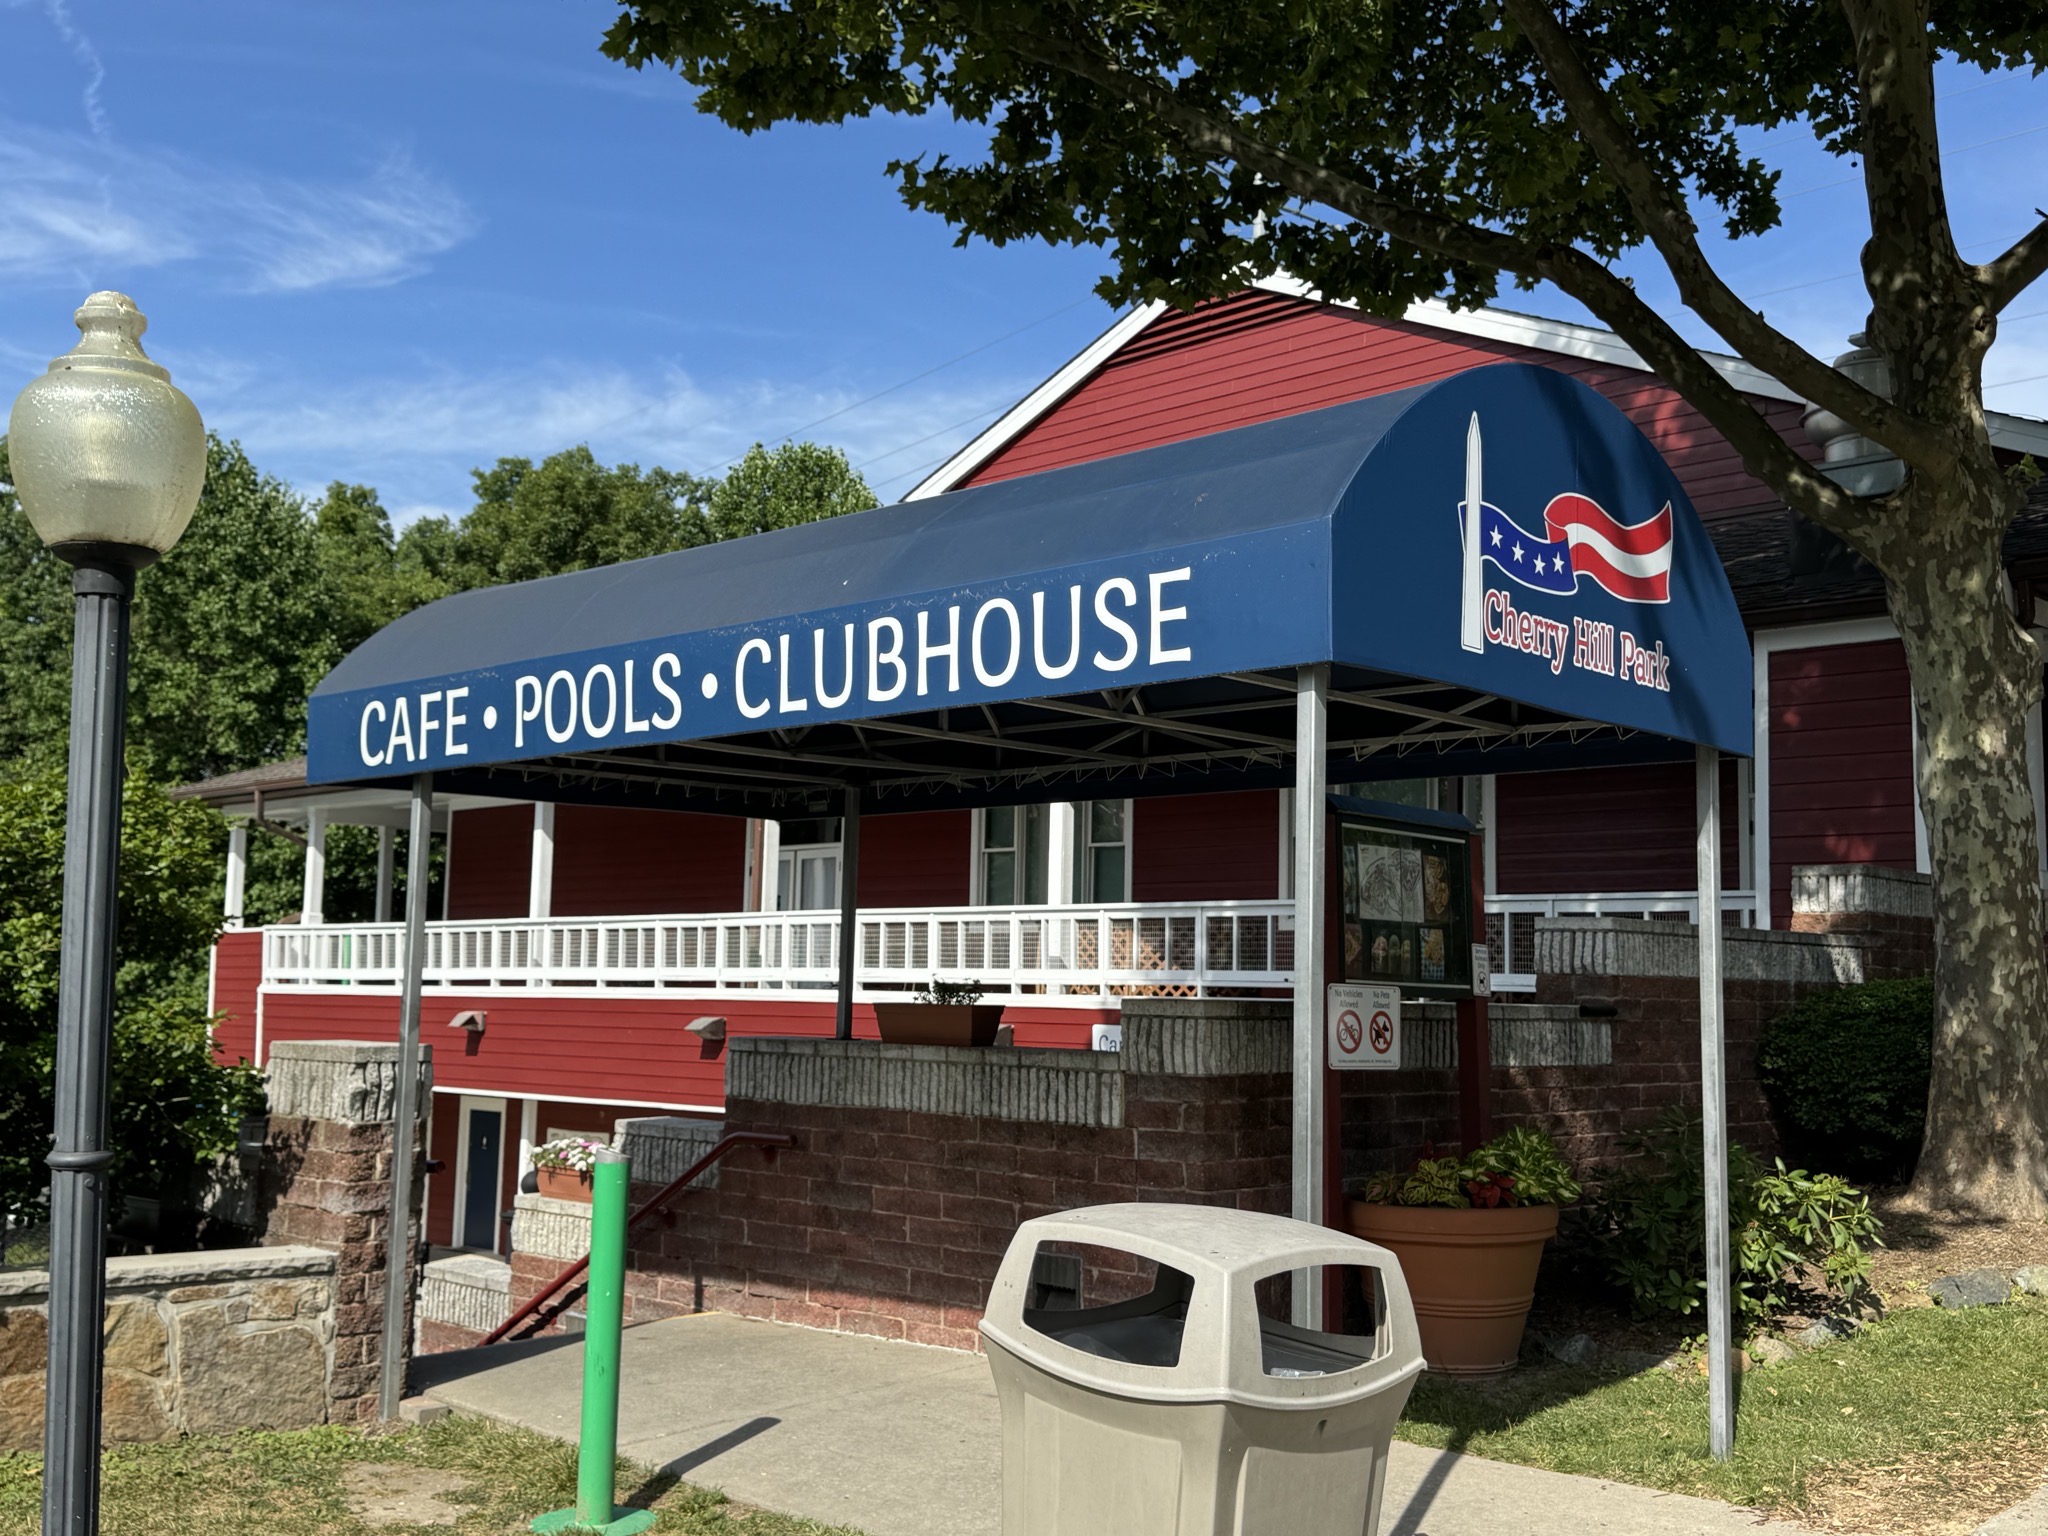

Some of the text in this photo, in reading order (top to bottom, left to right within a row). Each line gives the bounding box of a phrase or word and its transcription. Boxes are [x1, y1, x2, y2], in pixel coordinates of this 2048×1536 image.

[1483, 588, 1670, 692] Cherry Hill Park
[360, 566, 1192, 767] CAFE POOLS CLUBHOUSE
[1334, 989, 1364, 998] No Vehicles
[1372, 990, 1390, 999] No Pets
[1339, 999, 1359, 1008] Allowed
[1372, 1000, 1391, 1010] Allowed
